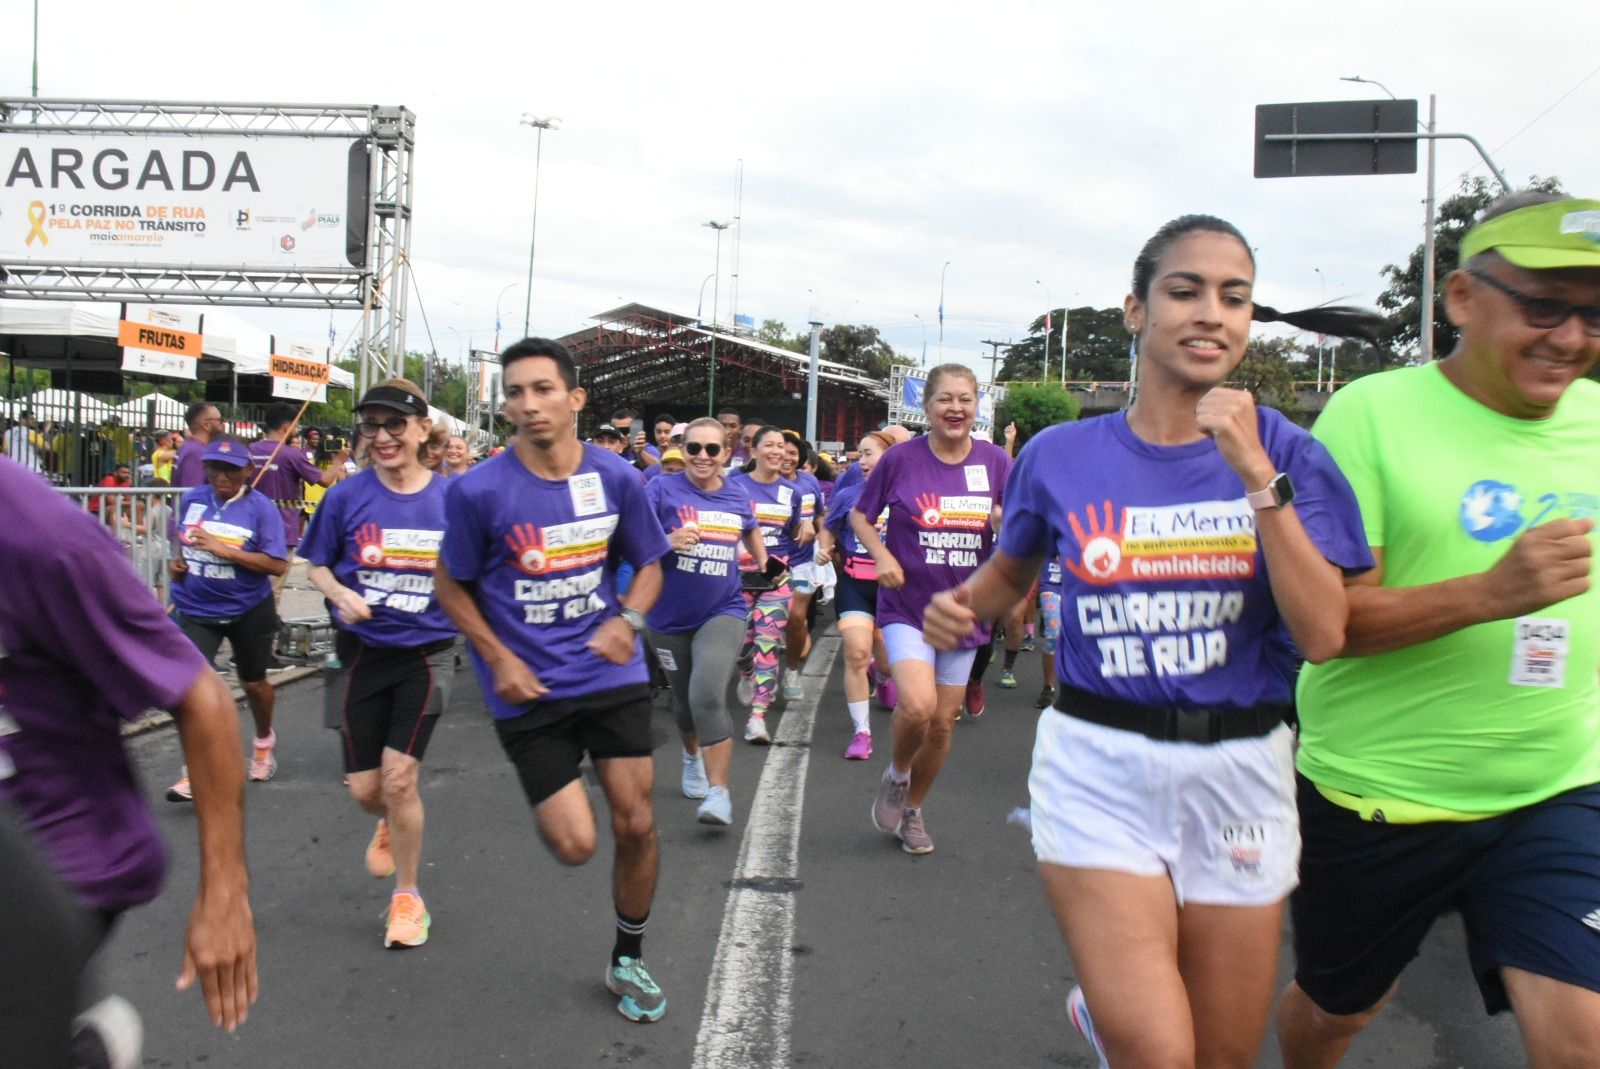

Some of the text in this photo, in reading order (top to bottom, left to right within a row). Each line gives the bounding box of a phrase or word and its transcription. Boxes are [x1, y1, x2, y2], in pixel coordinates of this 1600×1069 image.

[5, 147, 261, 192] ARGADA
[70, 204, 142, 218] CORRIDA
[146, 207, 168, 218] DE
[172, 207, 206, 219] RUA
[49, 217, 206, 232] PELA PAZ NO TRÂNSITO
[139, 328, 185, 350] FRUTAS
[272, 358, 328, 381] HIDRATAÇÃO
[1131, 513, 1161, 536] Ei,
[918, 531, 983, 549] CORRIDA
[676, 556, 728, 577] DE RUA
[925, 549, 978, 567] DE RUA
[1131, 553, 1250, 576] feminicídio
[523, 592, 607, 624] DE RUA
[1077, 590, 1244, 634] CORRIDA
[1097, 629, 1227, 678] DE RUA
[1223, 824, 1265, 842] 0741
